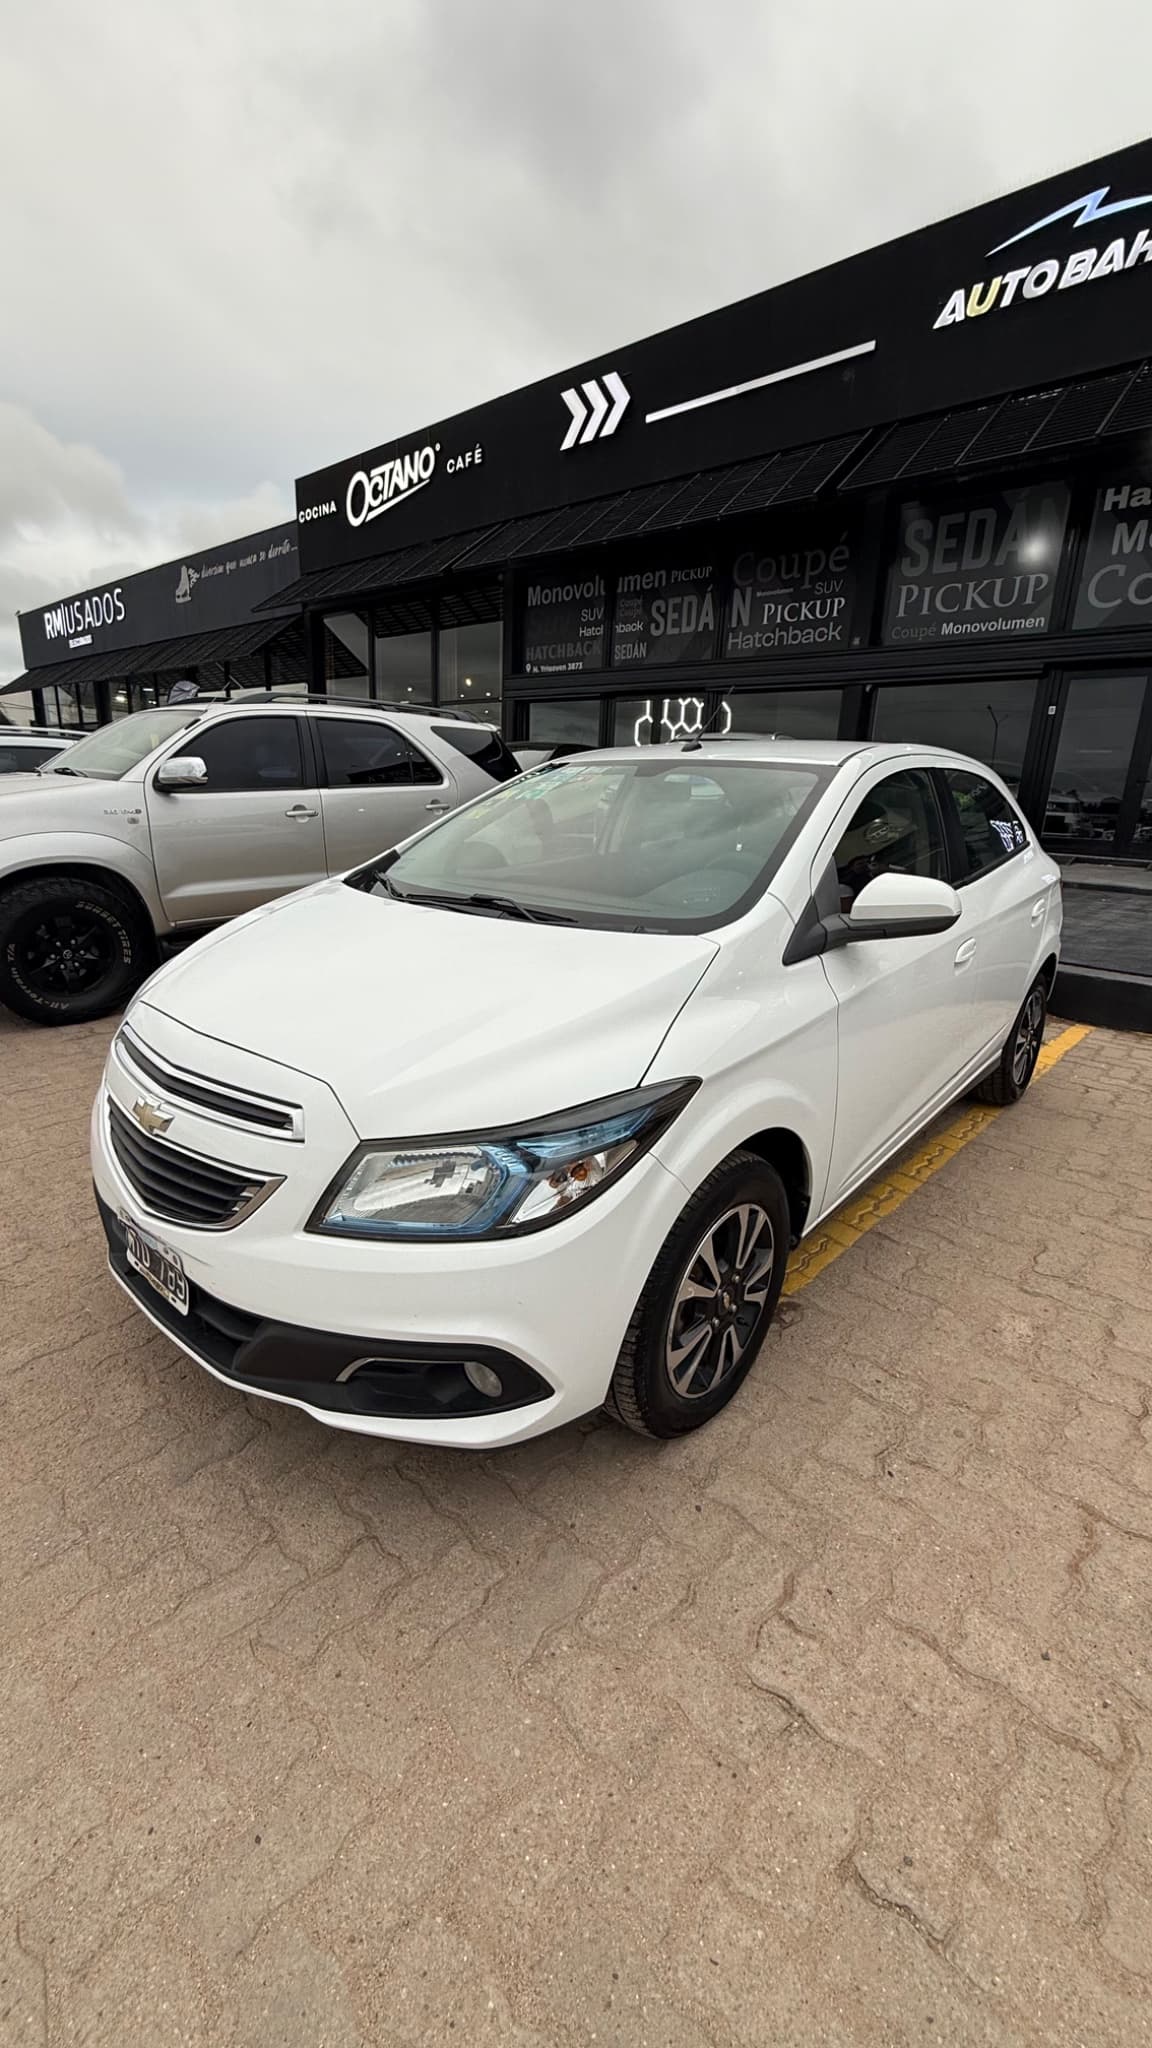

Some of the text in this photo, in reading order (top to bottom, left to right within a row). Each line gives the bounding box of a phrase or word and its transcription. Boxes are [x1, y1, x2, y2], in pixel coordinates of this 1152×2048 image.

[298, 501, 337, 523] COCINA
[447, 444, 483, 473] CAFÉ
[1111, 520, 1152, 556] M
[733, 528, 851, 590] Coupé
[671, 566, 713, 583] PICKUP
[814, 579, 845, 595] SUV
[896, 573, 1049, 618] PICKUP
[580, 607, 604, 622] SUV
[762, 597, 846, 624] PICKUP
[727, 622, 843, 650] Hatchback
[891, 615, 1046, 641] Coupé Monovolumen
[525, 640, 602, 661] HATCHBACK
